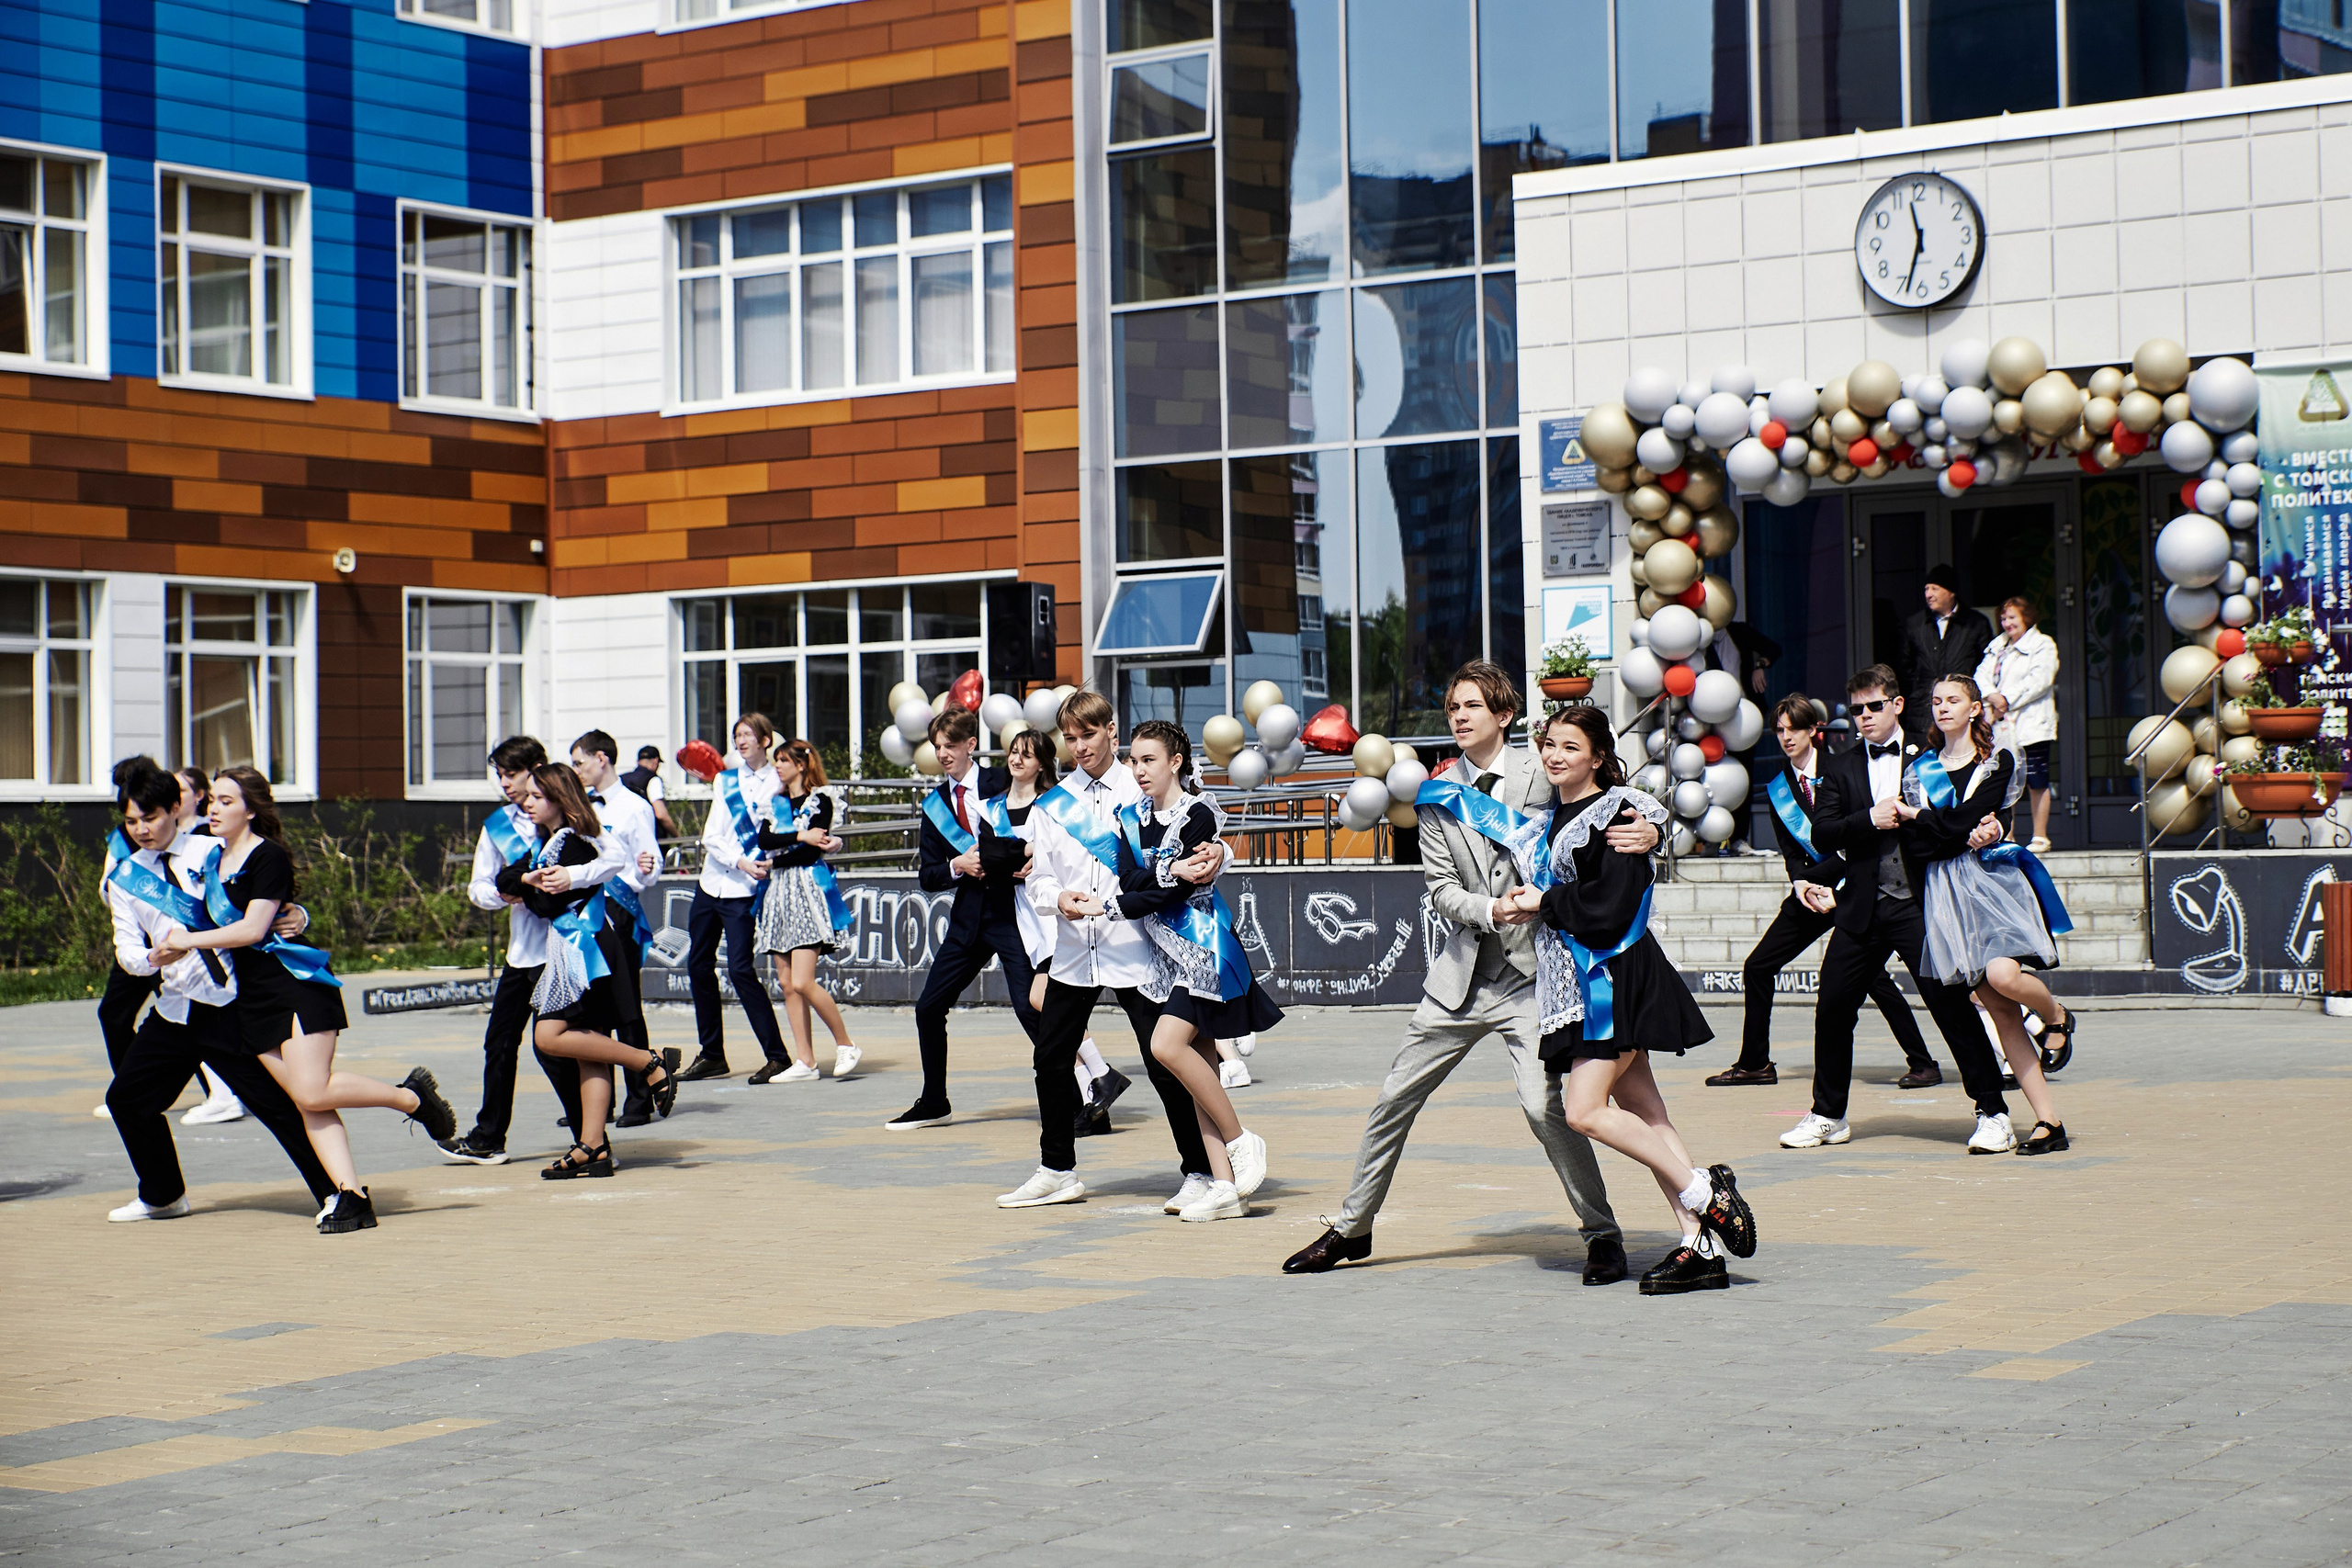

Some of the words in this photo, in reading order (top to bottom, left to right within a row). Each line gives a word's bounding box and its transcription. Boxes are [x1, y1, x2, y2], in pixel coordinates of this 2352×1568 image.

[1893, 191, 1903, 210] 11
[1912, 181, 1926, 202] 12
[1939, 186, 1944, 205] 1
[1874, 210, 1890, 230] 10
[1951, 201, 1962, 221] 2
[1961, 225, 1972, 245] 3
[1870, 237, 1882, 255] 9
[1878, 260, 1889, 278] 8
[1953, 252, 1966, 268] 4
[1895, 275, 1908, 295] 7
[1916, 279, 1928, 299] 6
[1939, 270, 1950, 290] 5
[2291, 448, 2352, 467] ВМЕСТ
[2273, 473, 2285, 488] С
[2289, 468, 2352, 487] ТОМСК
